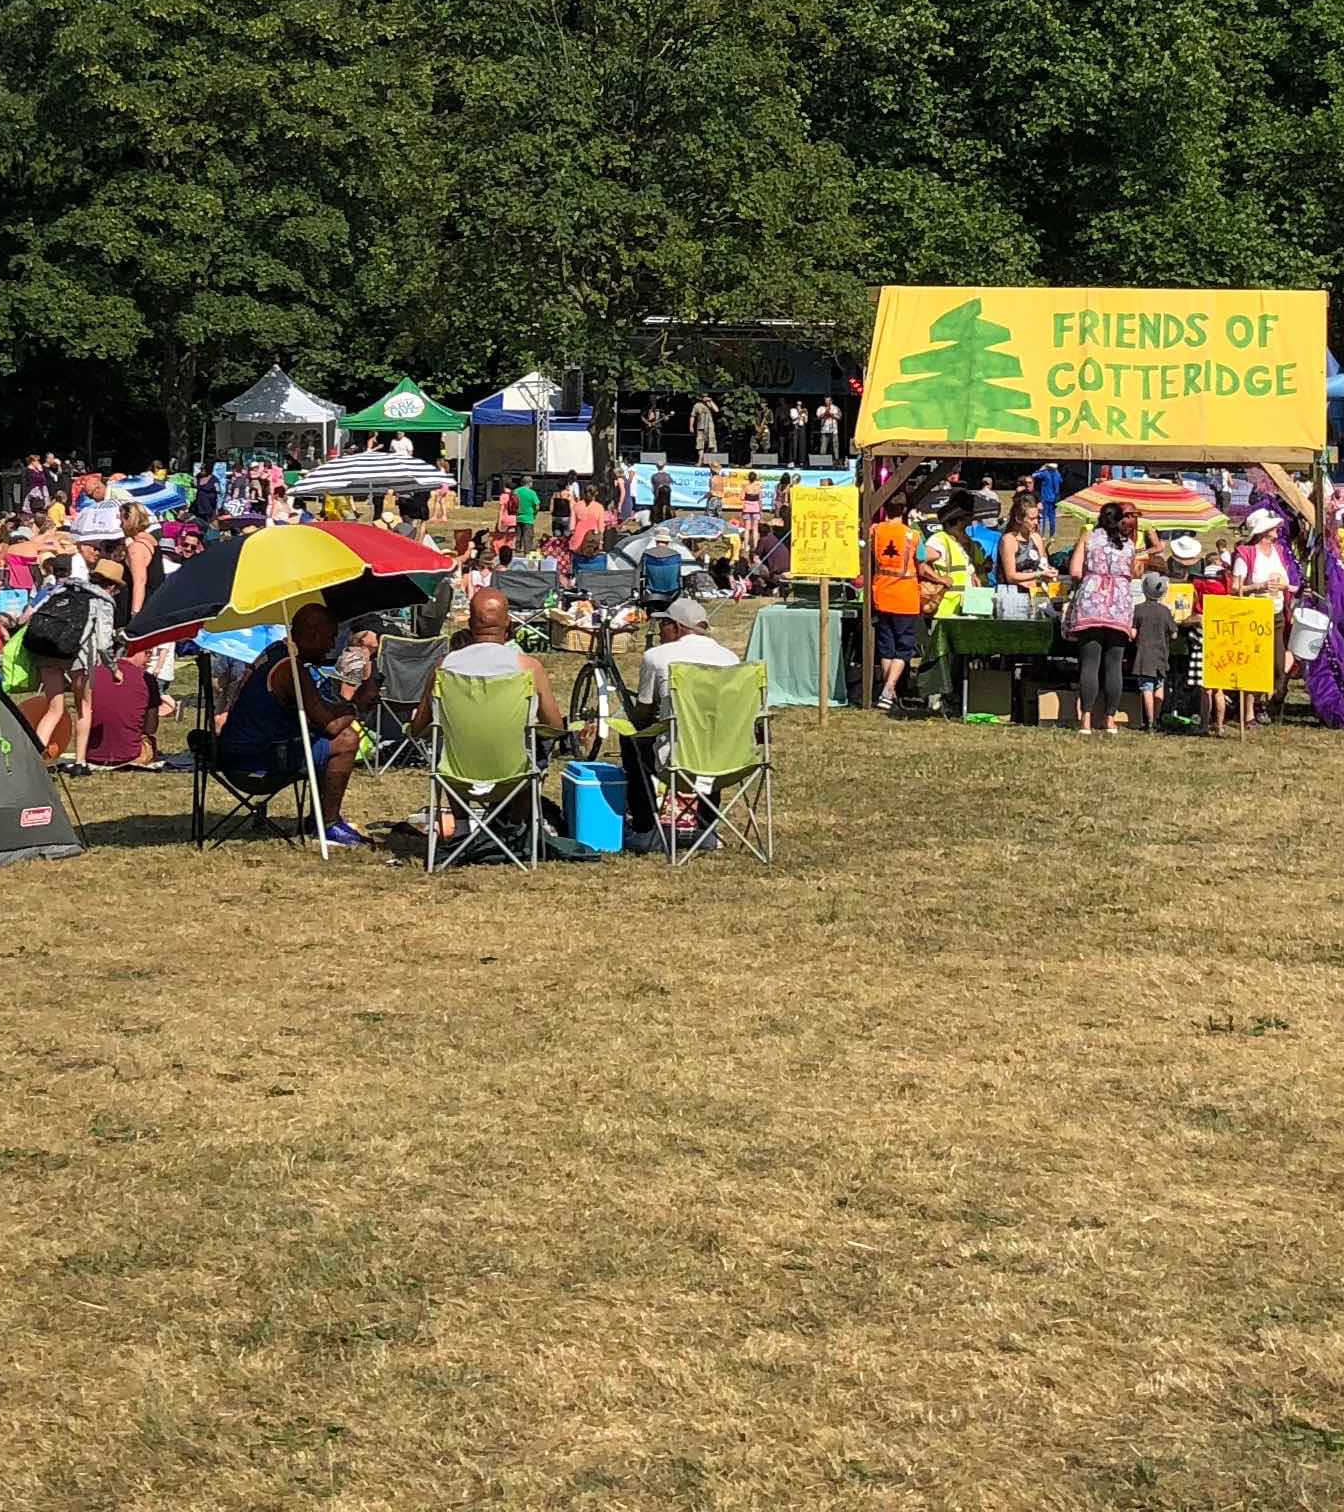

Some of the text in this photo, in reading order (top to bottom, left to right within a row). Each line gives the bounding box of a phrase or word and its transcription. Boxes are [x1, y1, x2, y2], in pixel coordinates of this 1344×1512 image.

[1053, 309, 1280, 349] FRIENDS OF
[1047, 357, 1298, 400] COTTERIDGE
[1049, 399, 1170, 441] PARK
[796, 520, 846, 539] HERE
[1211, 619, 1273, 637] TATOOS
